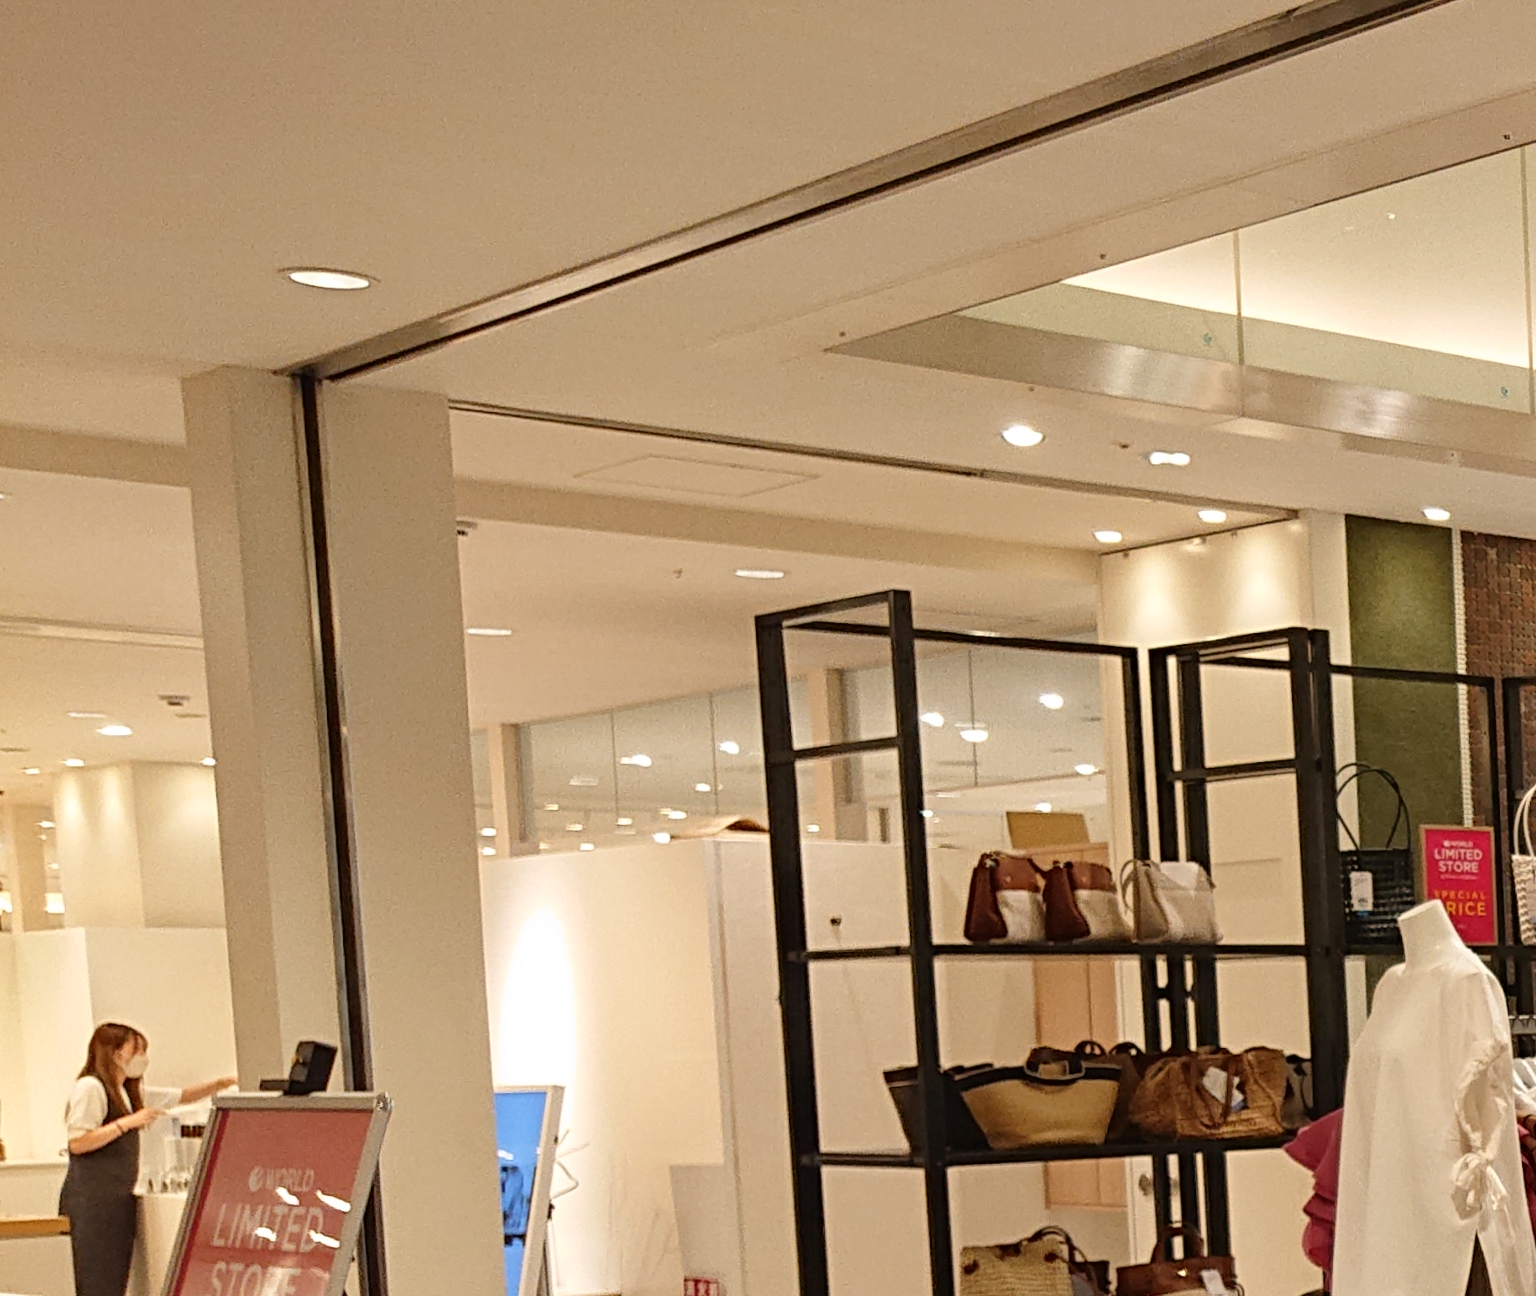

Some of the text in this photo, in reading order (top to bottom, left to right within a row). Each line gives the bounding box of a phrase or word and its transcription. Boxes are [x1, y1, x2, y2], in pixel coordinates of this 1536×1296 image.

[1434, 848, 1483, 861] LIMITED
[1438, 860, 1479, 873] STORE
[1445, 900, 1487, 917] RICE
[265, 1167, 315, 1192] WORLD
[211, 1203, 324, 1252] LIMITED
